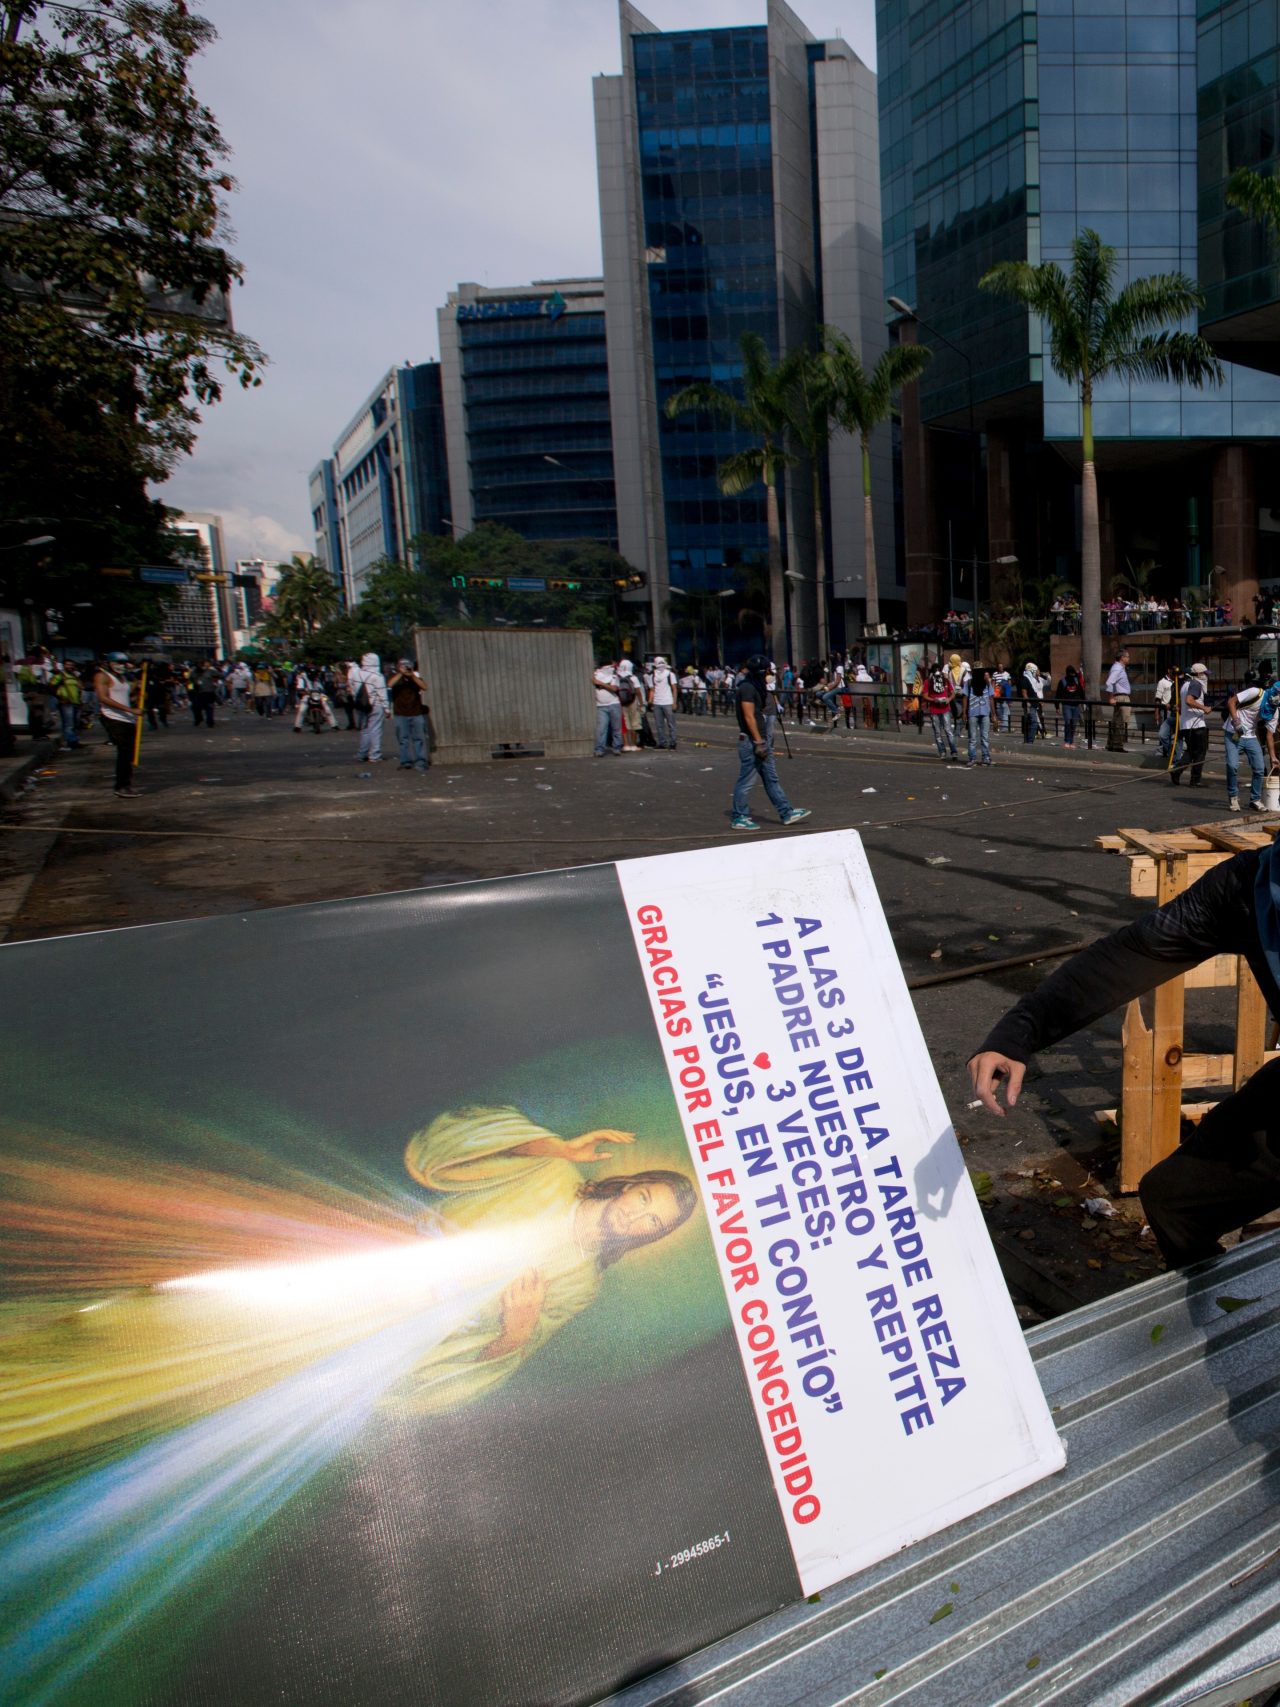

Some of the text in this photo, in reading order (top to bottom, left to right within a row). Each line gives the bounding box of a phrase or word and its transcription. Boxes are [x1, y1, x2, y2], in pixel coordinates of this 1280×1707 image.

[698, 973, 755, 1117] “JESUS,
[637, 905, 821, 1524] GRACIAS POR EL FAVOR CONCEDIDO
[735, 1123, 778, 1177] EN
[756, 912, 934, 1436] 1 PADRE NUESTRO Y REPITE
[756, 1184, 790, 1227] TI
[766, 1080, 835, 1249] 3 VECES:
[795, 916, 966, 1405] A LAS 3 DE LA TARDE REZA
[654, 1560, 662, 1576] J
[670, 1530, 731, 1570] 29945865-1
